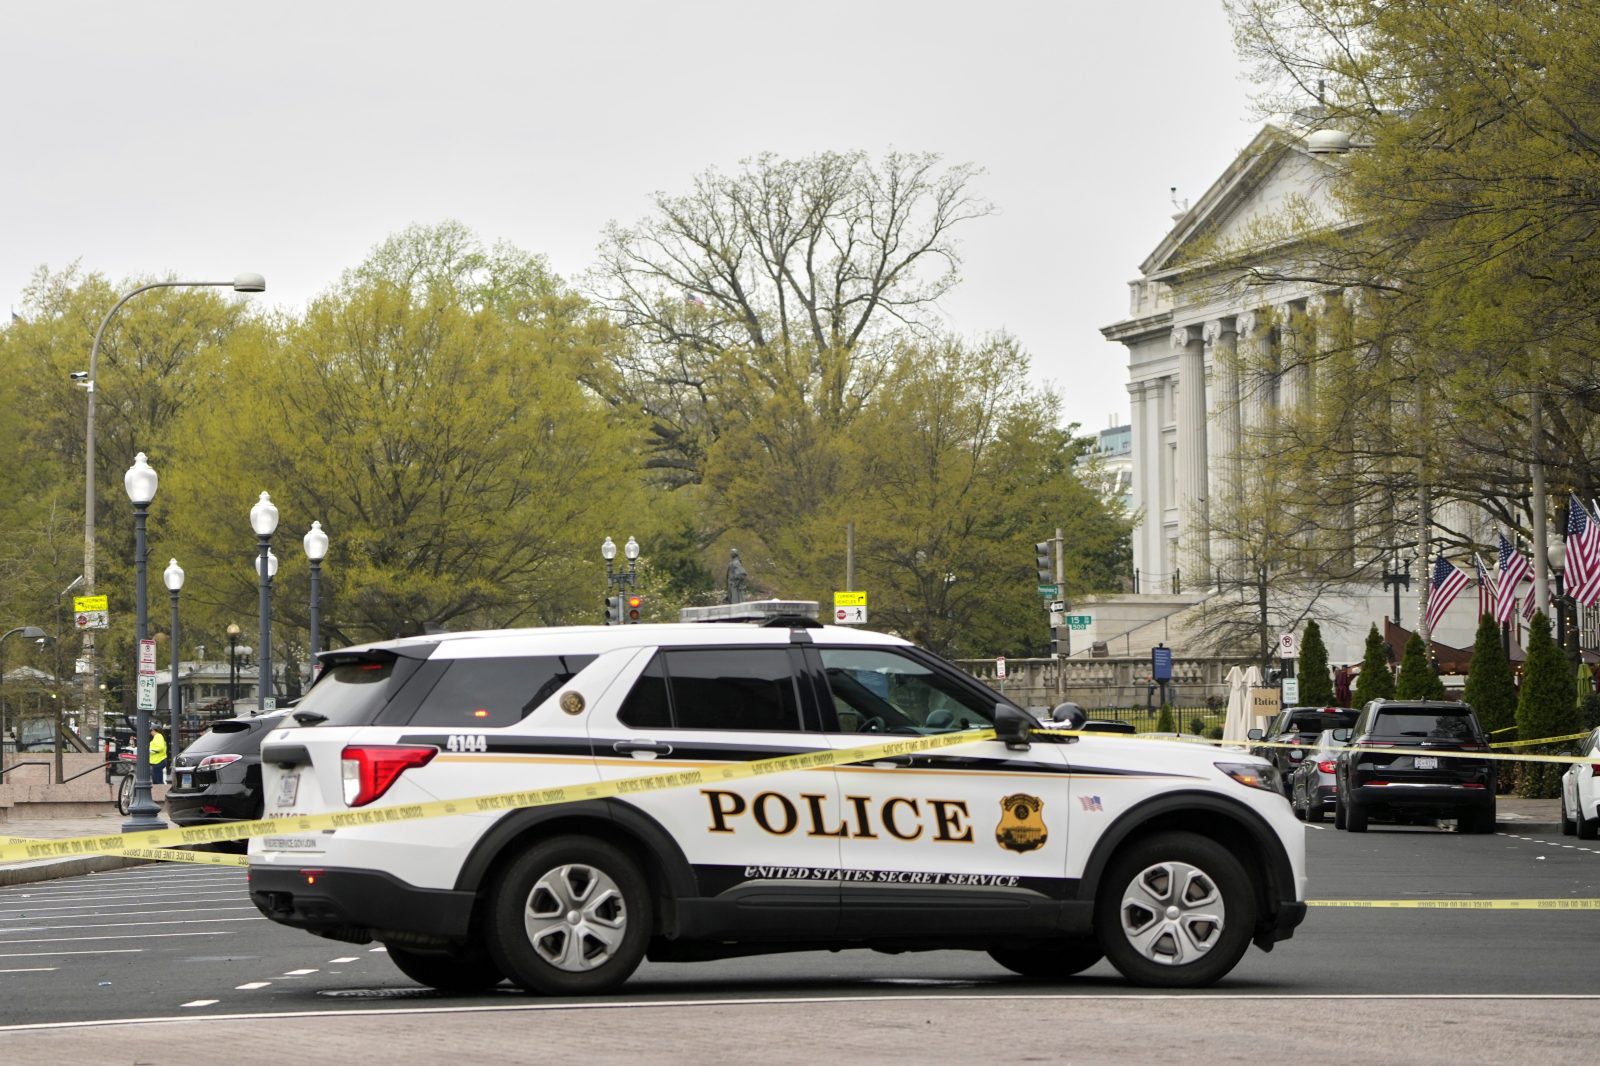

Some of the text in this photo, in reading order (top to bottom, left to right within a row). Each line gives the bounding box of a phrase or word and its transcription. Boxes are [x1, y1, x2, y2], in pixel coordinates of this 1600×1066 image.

[1254, 697, 1278, 705] Patio
[446, 735, 488, 752] 4144
[700, 788, 974, 844] POLICE
[142, 848, 154, 858] NOT
[154, 849, 162, 858] DO
[164, 850, 176, 860] LINE
[176, 852, 195, 862] POLICE
[238, 856, 248, 866] OSS
[744, 866, 1020, 887] UNITED STATES SECRET SERVICE
